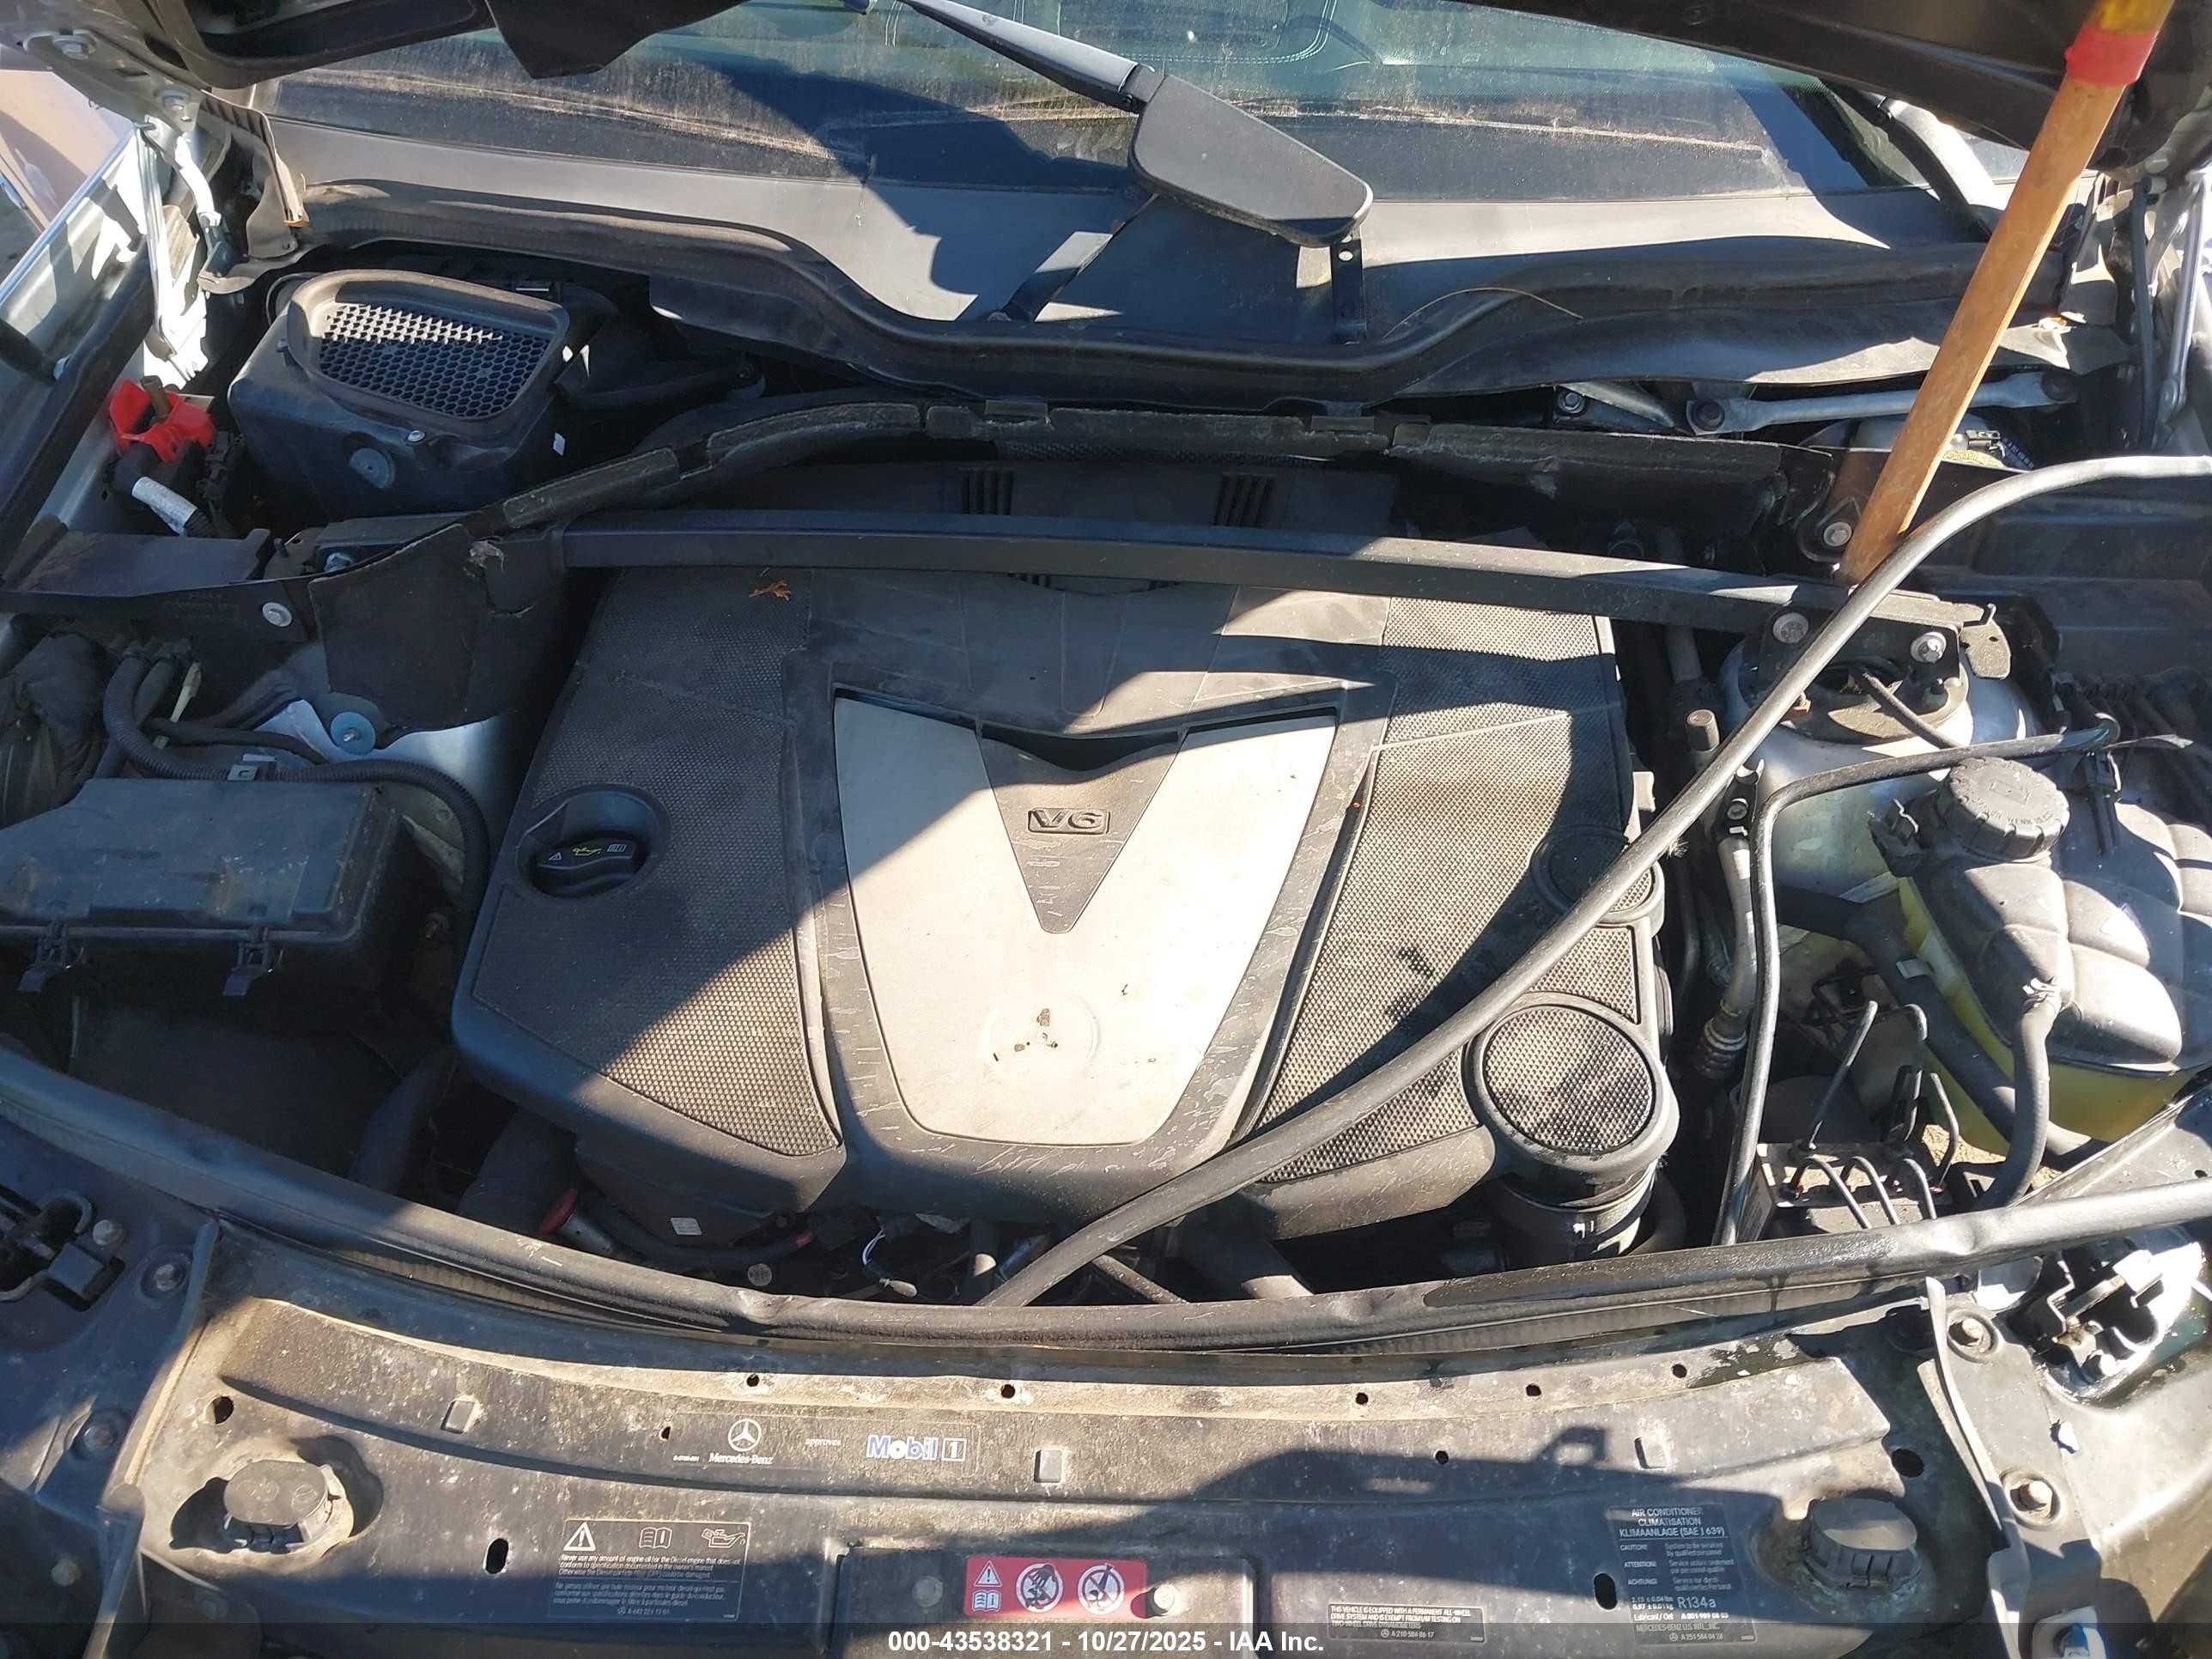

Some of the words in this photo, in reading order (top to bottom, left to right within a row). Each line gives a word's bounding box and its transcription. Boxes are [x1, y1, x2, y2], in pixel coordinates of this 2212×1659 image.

[1033, 810, 1103, 830] V6
[866, 1434, 939, 1461] Mobil
[708, 1453, 775, 1465] Mercedes-Benz
[1632, 1509, 1645, 1518] AIR
[1646, 1507, 1704, 1517] CONDITIONER
[1638, 1517, 1702, 1528] CLIMATISATION
[1619, 1528, 1680, 1538] KLIMAANLAGE
[1680, 1527, 1698, 1537] (SAE
[1705, 1527, 1725, 1537] 639)
[1677, 1595, 1717, 1608] R134a
